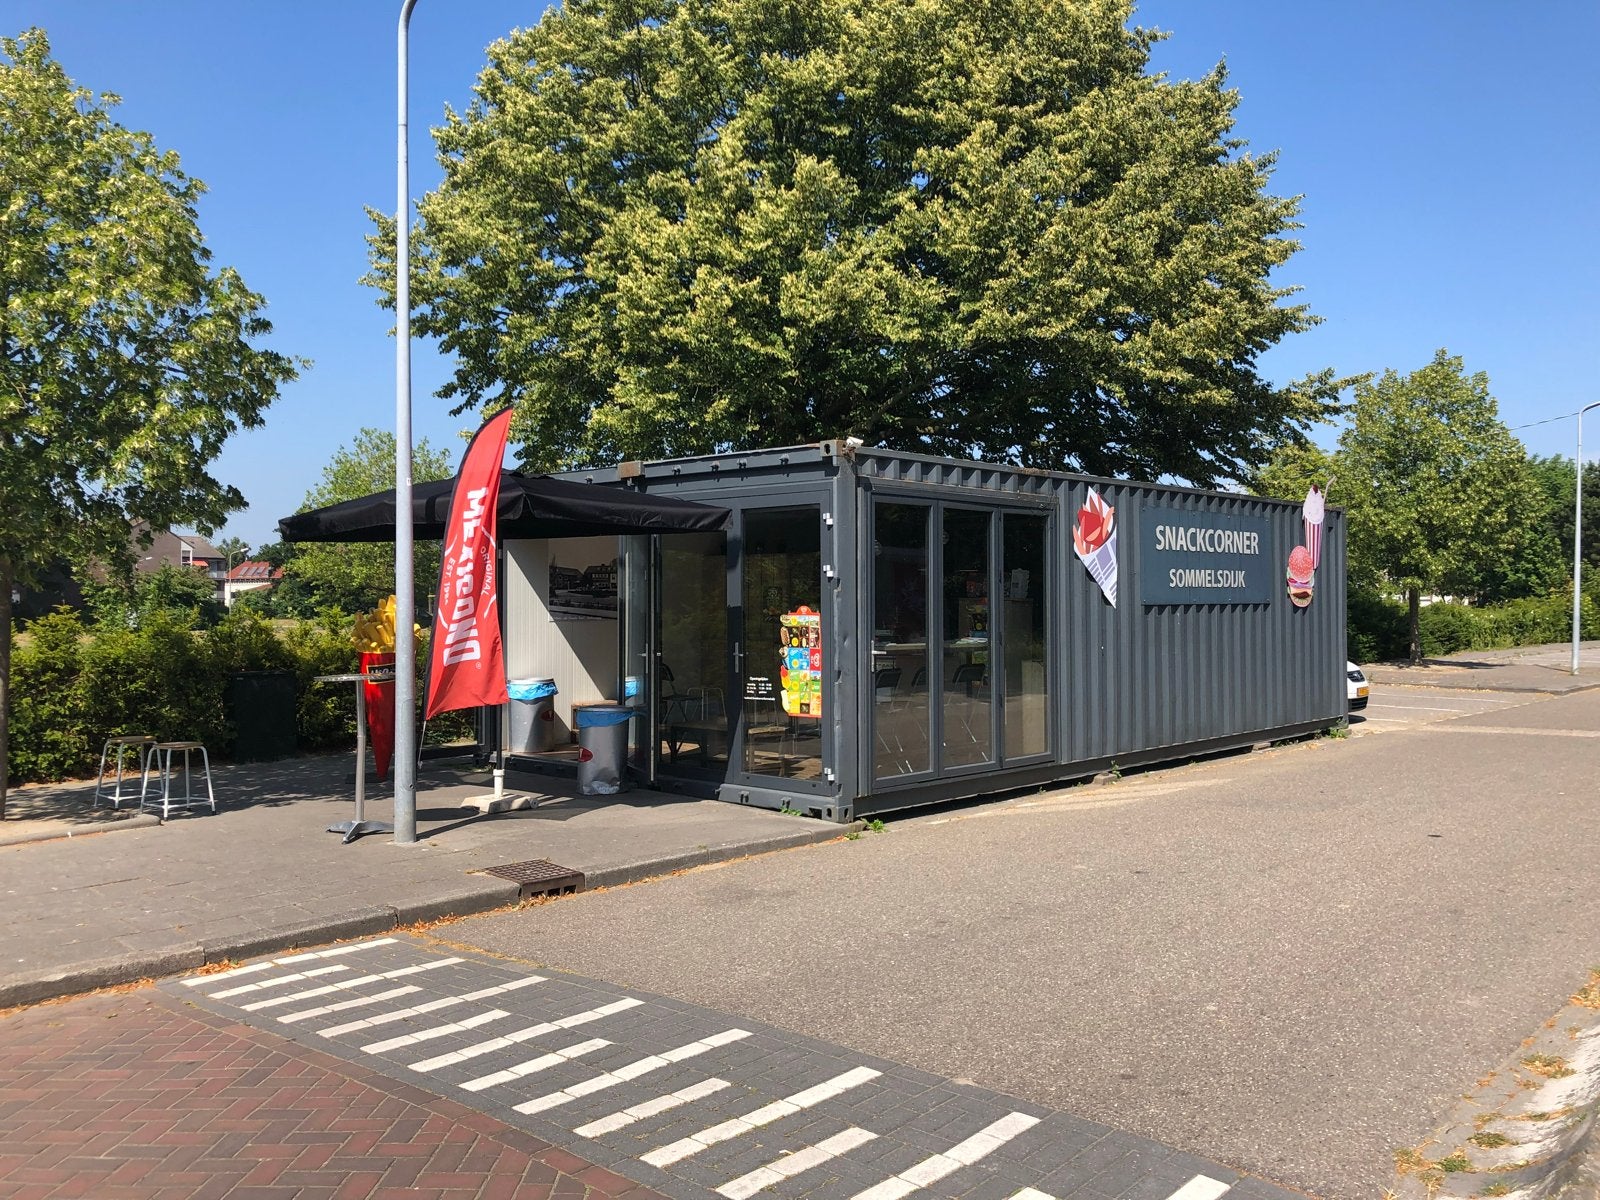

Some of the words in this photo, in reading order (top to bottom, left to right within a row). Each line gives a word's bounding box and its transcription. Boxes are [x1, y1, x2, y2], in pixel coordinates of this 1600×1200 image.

[1155, 525, 1259, 555] SNACKCORNER
[443, 487, 488, 667] MEXICANO
[444, 557, 456, 579] EST.
[480, 545, 493, 596] ORIGINAL
[1169, 568, 1246, 588] SOMMELSDIJK
